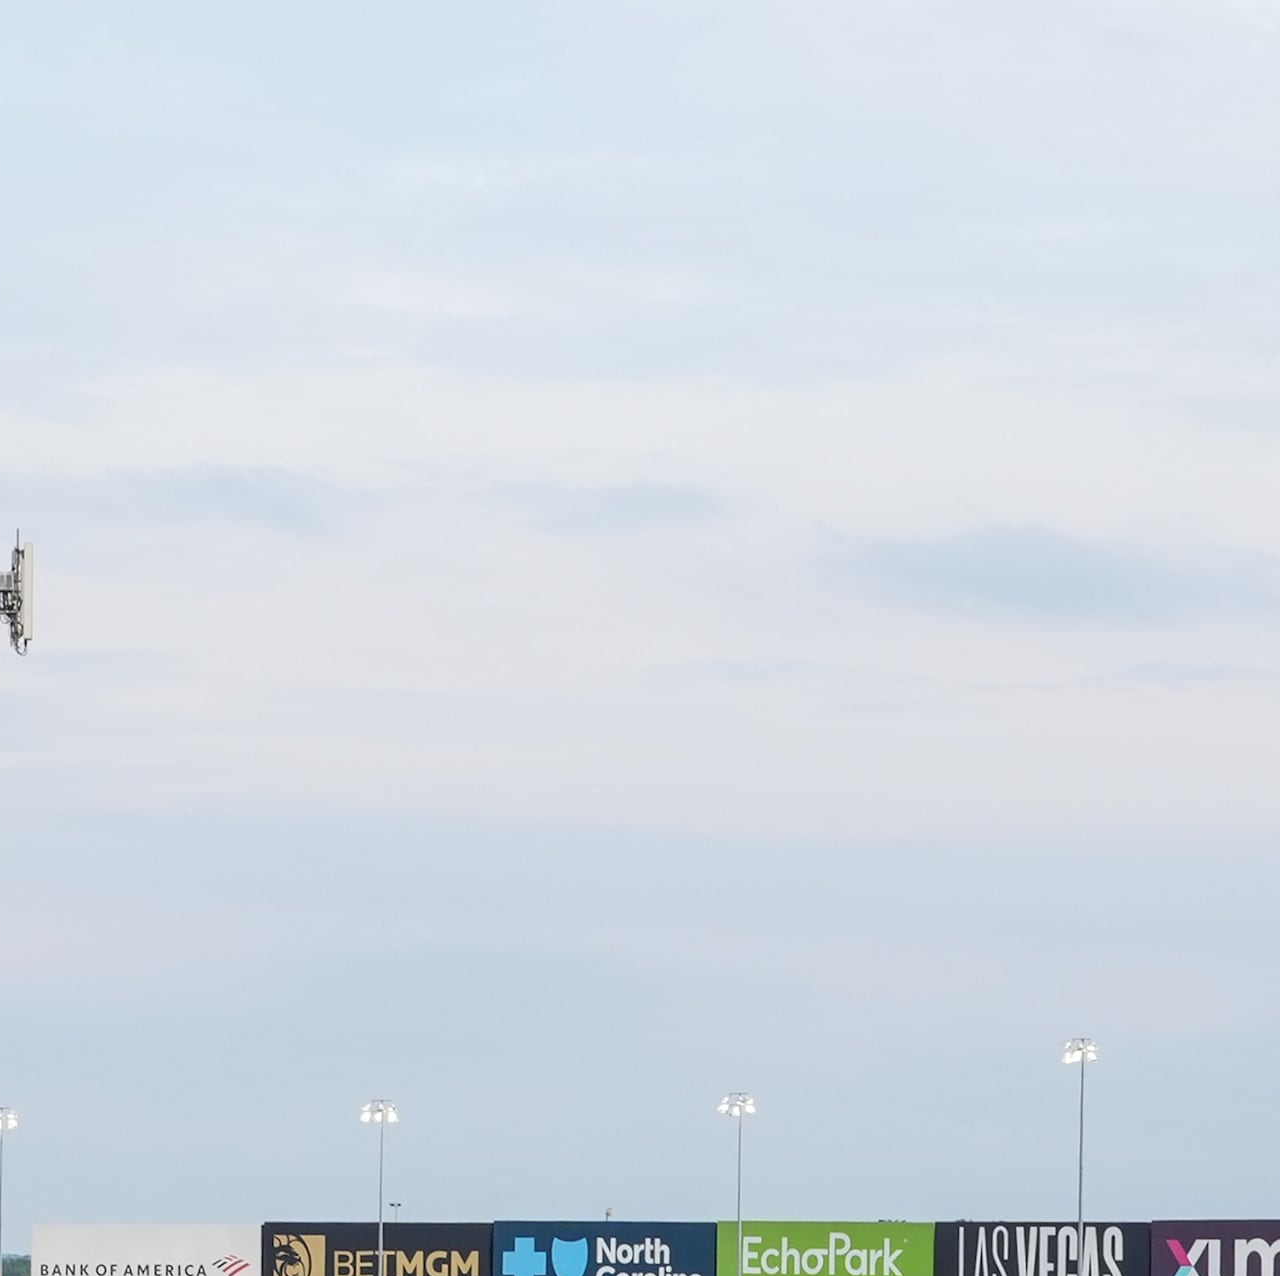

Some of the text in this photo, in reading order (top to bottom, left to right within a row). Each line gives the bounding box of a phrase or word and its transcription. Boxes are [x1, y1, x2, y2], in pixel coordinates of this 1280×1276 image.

[596, 1236, 671, 1265] North
[39, 1263, 90, 1276] BANK
[95, 1263, 119, 1276] OF
